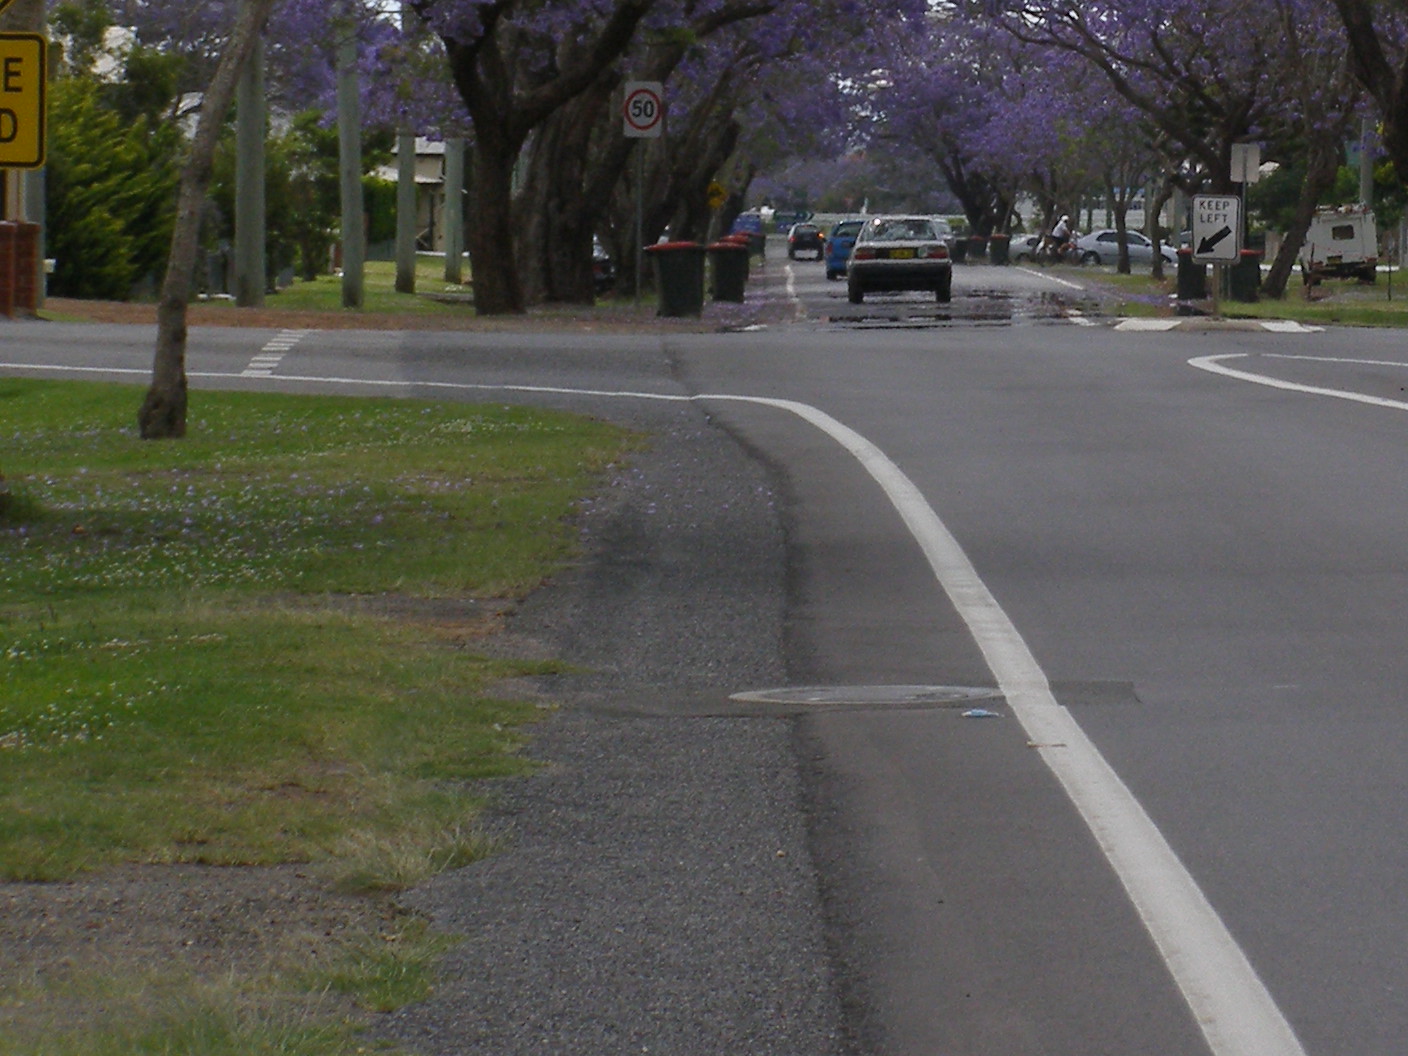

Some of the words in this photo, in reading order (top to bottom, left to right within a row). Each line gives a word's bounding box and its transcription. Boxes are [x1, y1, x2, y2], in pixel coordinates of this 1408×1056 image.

[4, 57, 23, 92] E
[632, 100, 654, 118] 50
[1199, 199, 1230, 211] KEEP
[1200, 213, 1228, 224] LEFT
